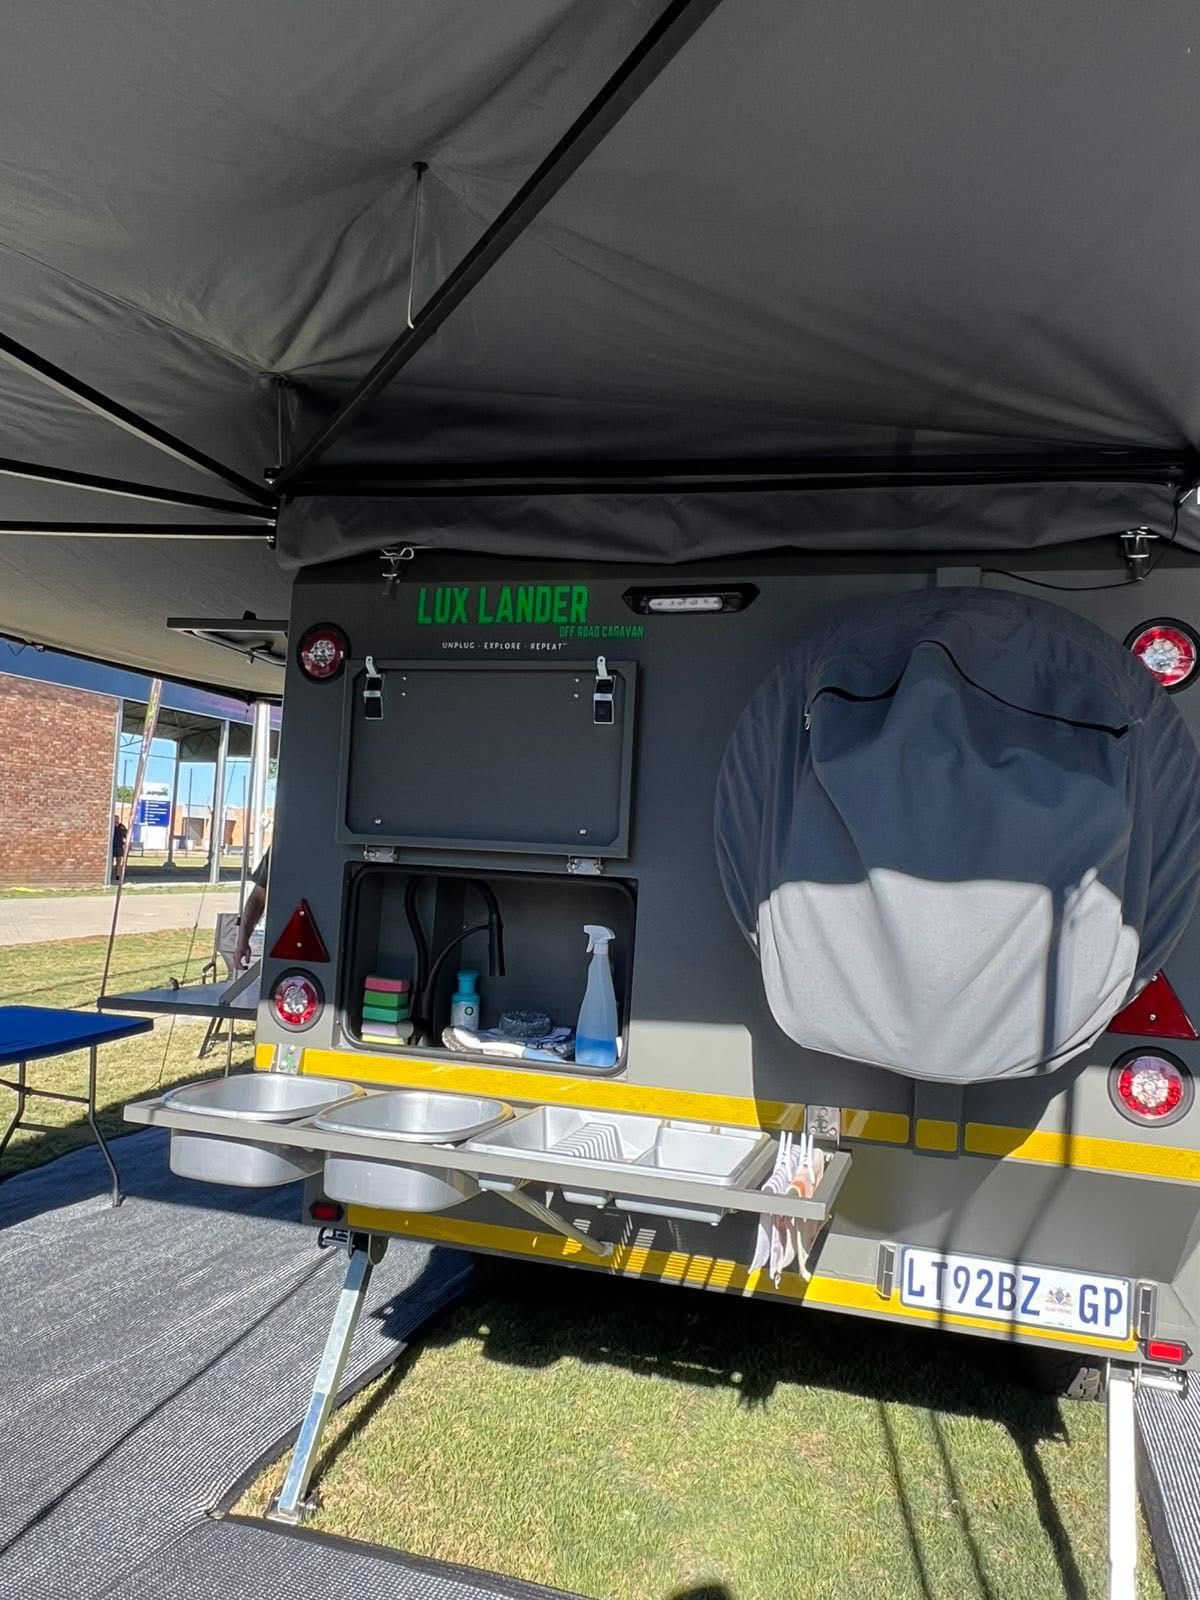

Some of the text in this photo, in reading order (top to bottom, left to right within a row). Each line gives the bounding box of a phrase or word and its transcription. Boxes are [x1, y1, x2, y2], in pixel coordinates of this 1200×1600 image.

[418, 586, 588, 624] LUX LANDER
[559, 625, 644, 637] OFF ROAD CARAVAN
[484, 642, 521, 650] EXPLORE
[907, 1257, 1123, 1327] LT92BZ GP
